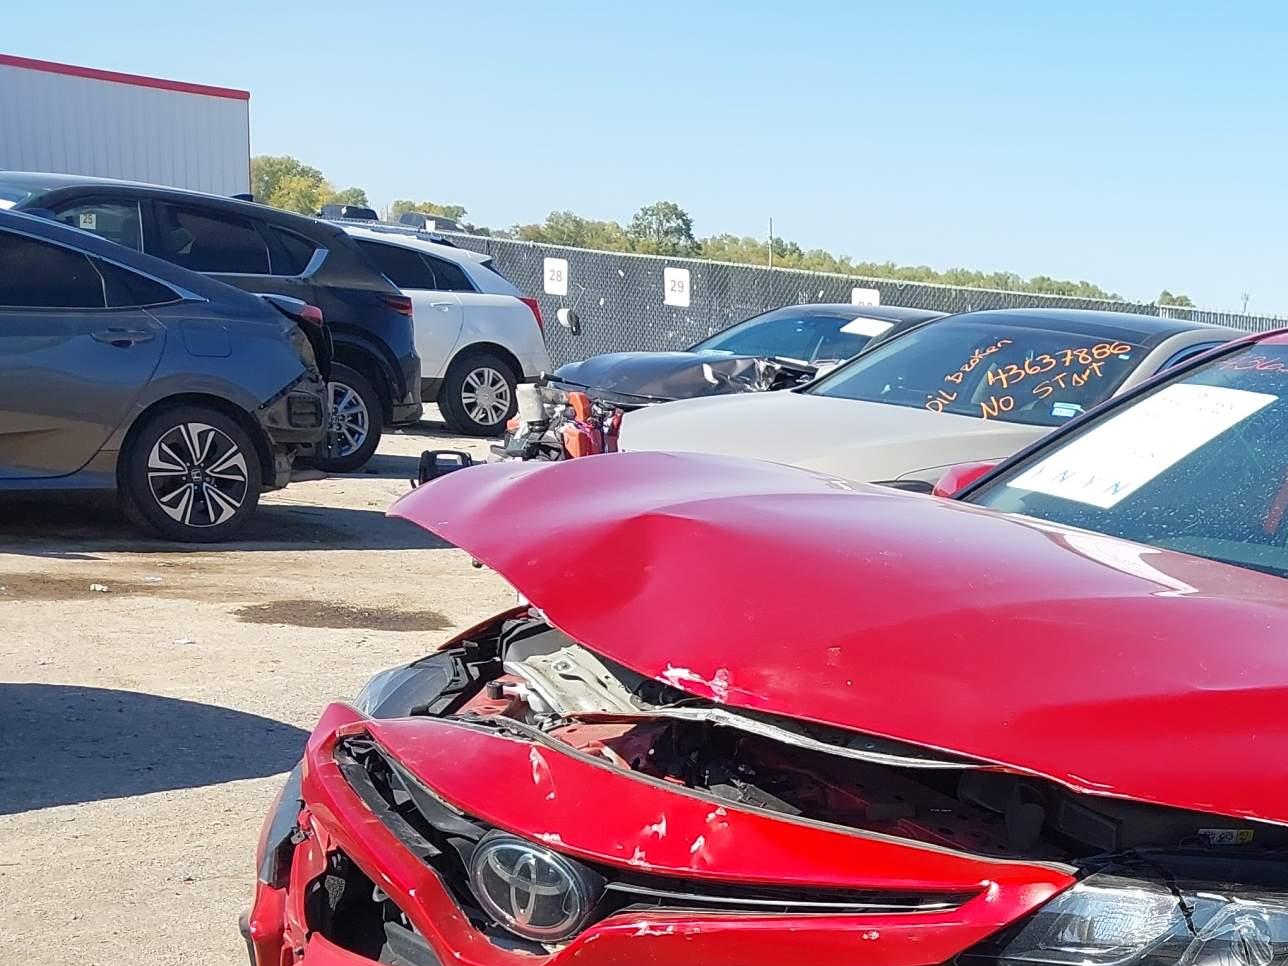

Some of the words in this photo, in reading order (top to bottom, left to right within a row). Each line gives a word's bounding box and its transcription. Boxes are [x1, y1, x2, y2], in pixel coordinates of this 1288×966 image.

[83, 214, 93, 224] 25
[549, 269, 563, 282] 28
[670, 279, 684, 293] 29
[987, 341, 1132, 389] 43637886
[980, 395, 1015, 420] NO
